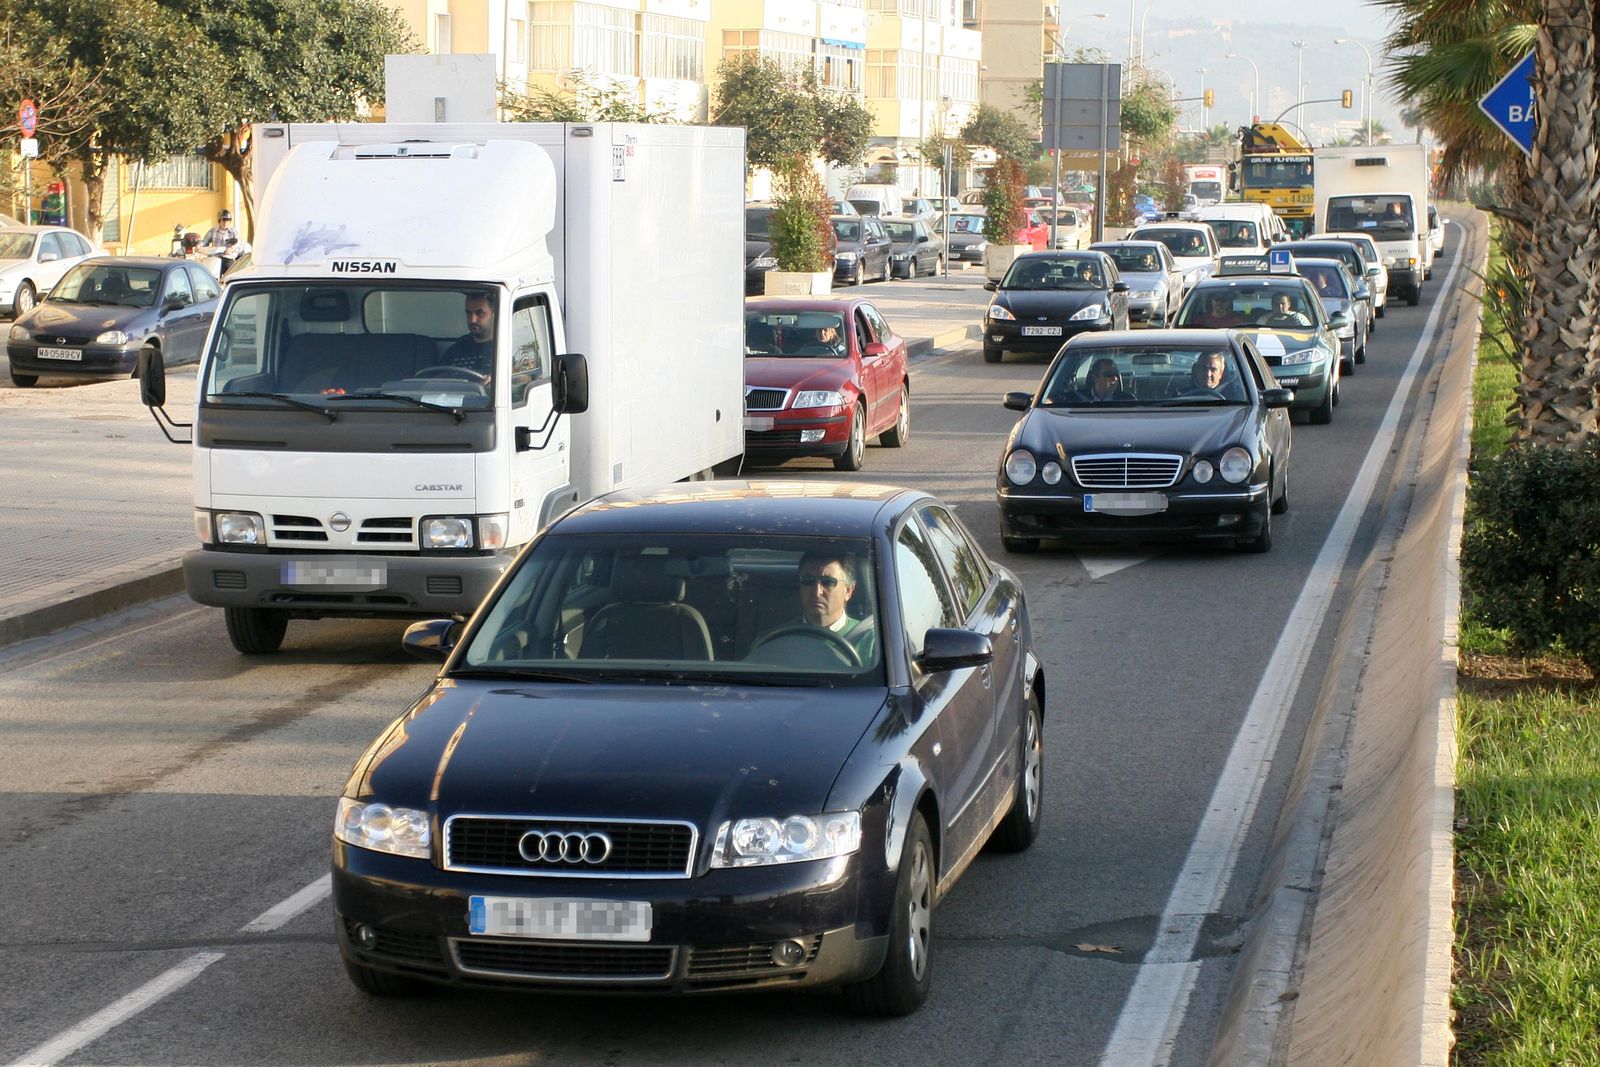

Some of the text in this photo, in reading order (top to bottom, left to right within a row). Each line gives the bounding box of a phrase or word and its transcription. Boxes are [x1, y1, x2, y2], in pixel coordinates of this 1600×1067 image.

[1508, 101, 1536, 123] BÁ
[1275, 253, 1285, 264] L
[332, 261, 397, 273] NISSAN
[1026, 327, 1061, 335] 7292 CZJ
